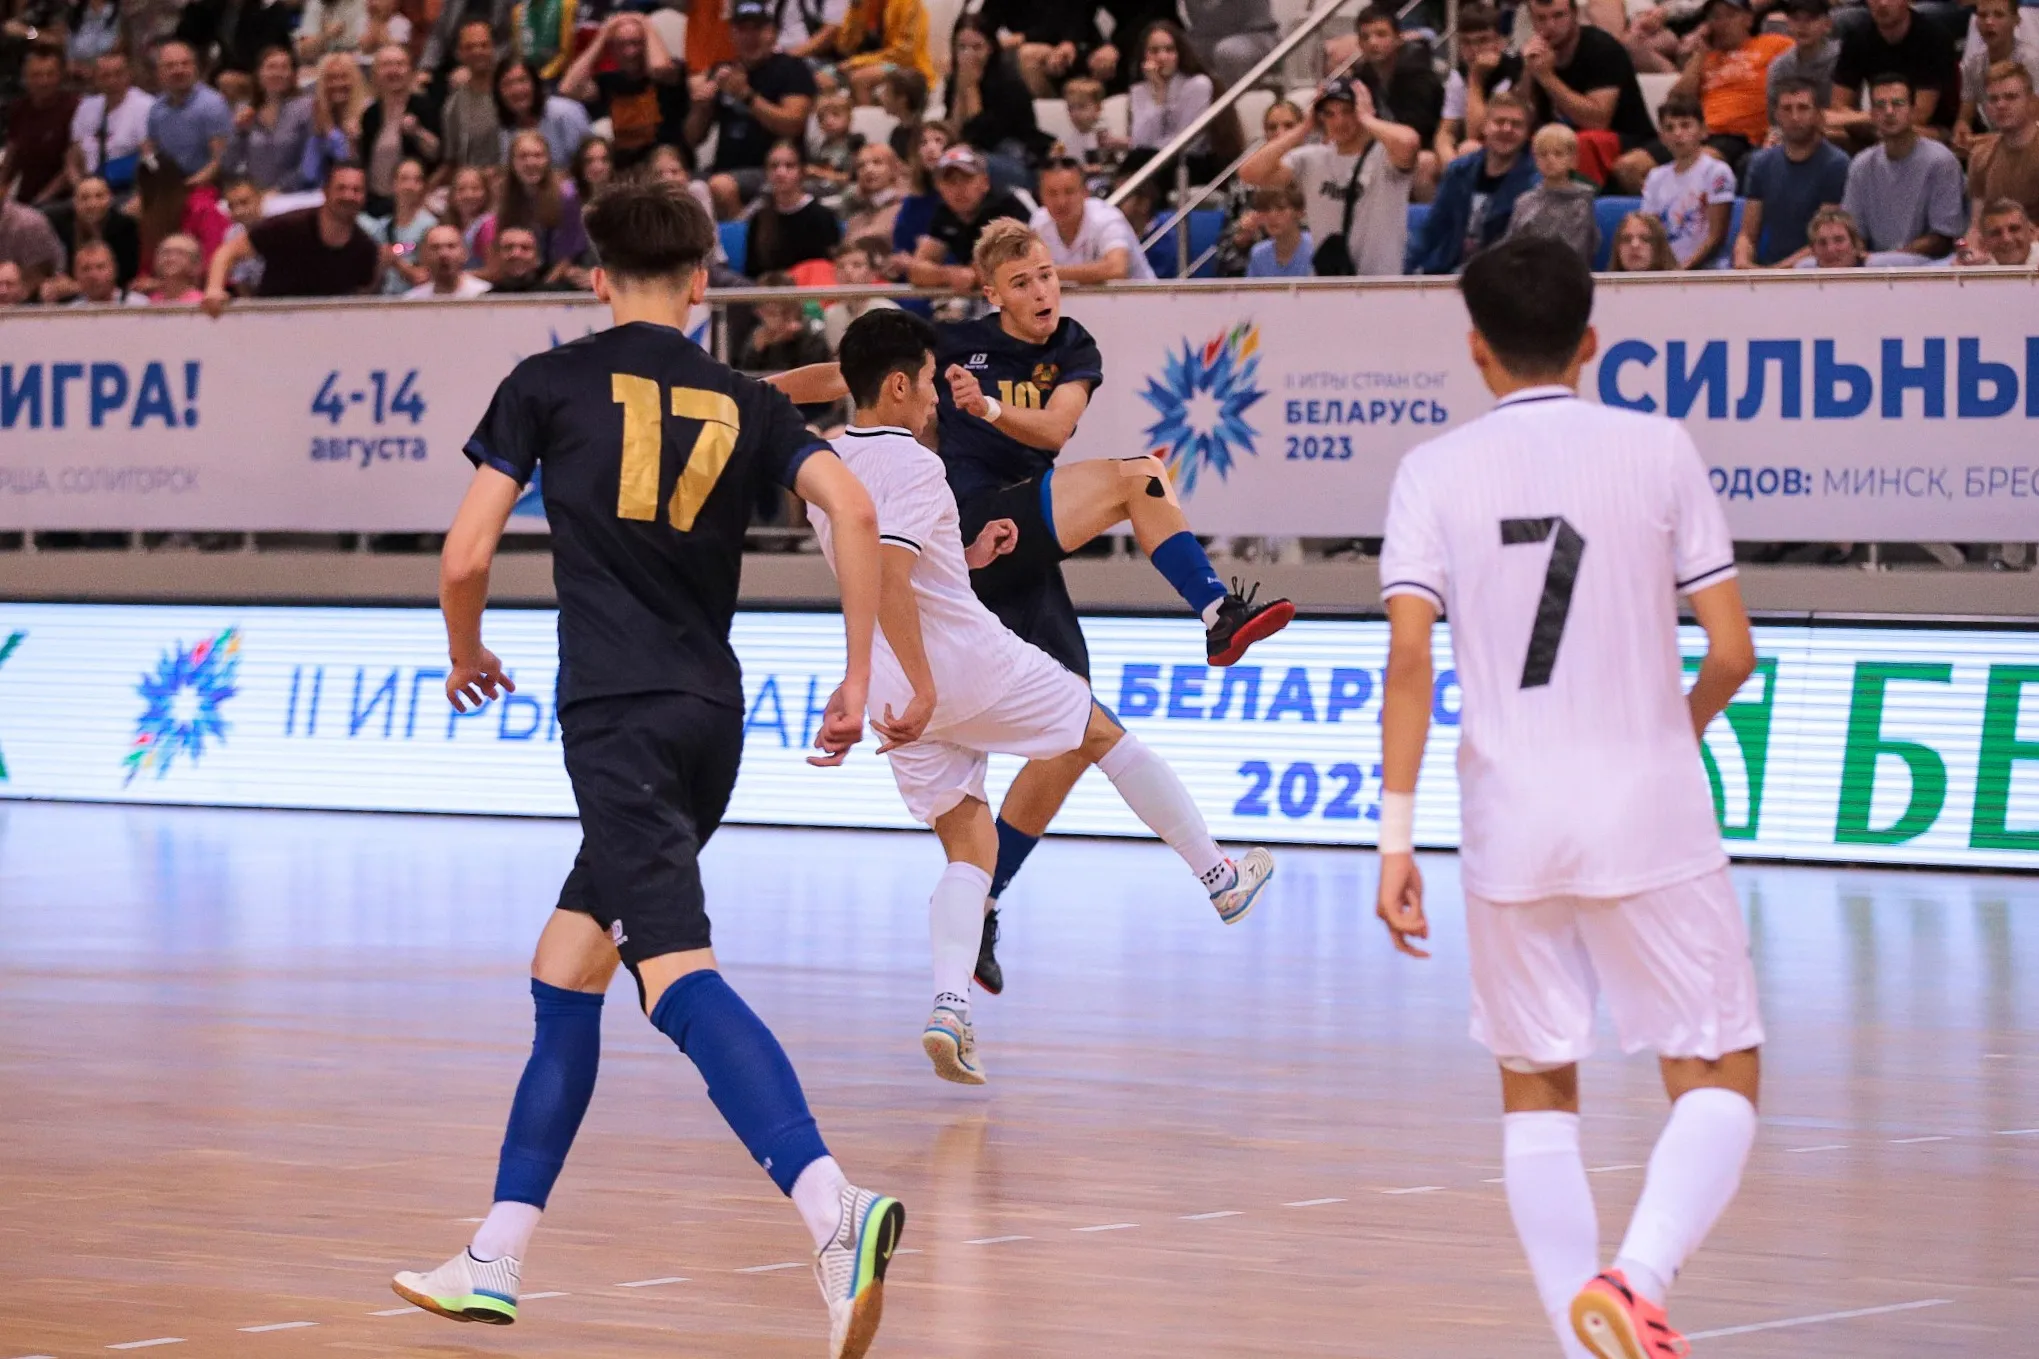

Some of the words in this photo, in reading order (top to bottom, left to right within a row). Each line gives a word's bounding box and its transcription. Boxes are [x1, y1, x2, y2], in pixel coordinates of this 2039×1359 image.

[0, 361, 201, 428] ИГРА!
[311, 369, 427, 424] 4-14
[1598, 336, 2039, 420] СИЛЬНЫ
[1286, 400, 1448, 425] БЕЛАРУСЬ
[311, 436, 427, 468] августа
[611, 373, 740, 532] 17
[1286, 435, 1353, 460] 2023
[1824, 467, 1953, 500] МИНСК,
[1501, 516, 1587, 689] 7
